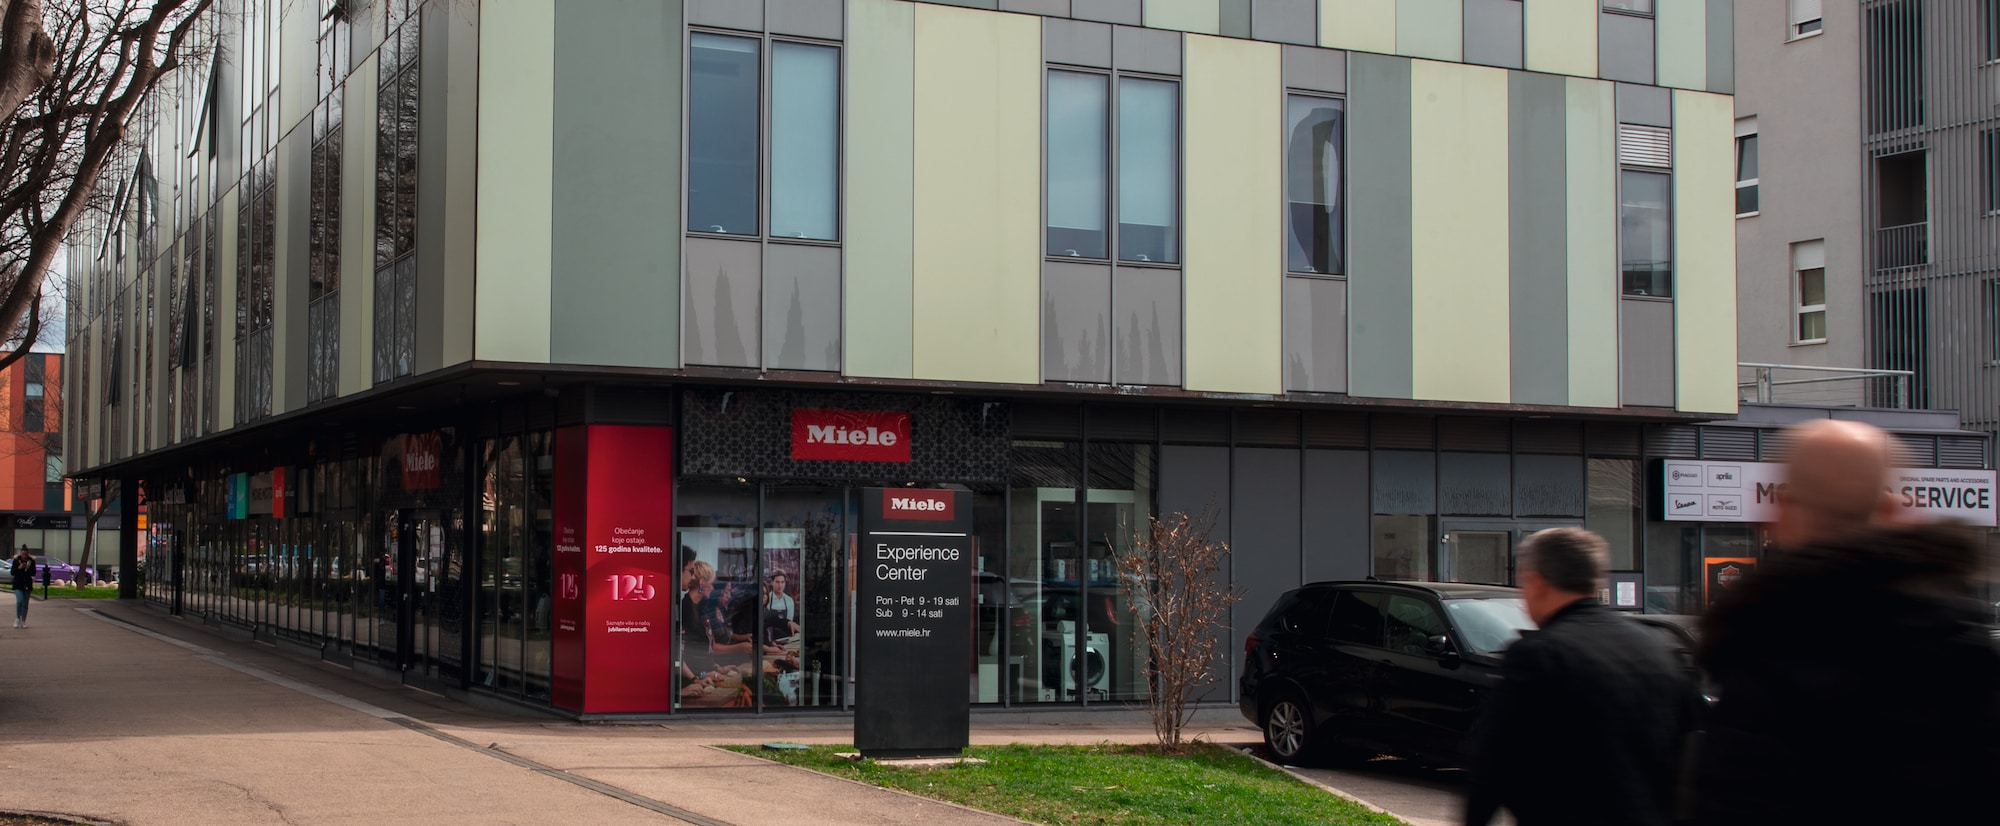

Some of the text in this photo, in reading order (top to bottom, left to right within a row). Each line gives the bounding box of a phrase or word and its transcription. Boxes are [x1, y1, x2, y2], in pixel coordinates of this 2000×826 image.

[807, 425, 897, 446] Miele
[406, 451, 435, 472] Miele
[891, 497, 946, 511] Miele
[1901, 486, 1989, 509] SERVICE
[614, 527, 645, 536] Obećanje
[611, 536, 625, 545] koje
[595, 545, 608, 553] 125
[608, 545, 631, 554] godina
[876, 543, 959, 563] Experience
[876, 564, 927, 580] Center
[605, 574, 656, 601] 125
[876, 595, 893, 605] Pon
[901, 596, 915, 605] Pet
[918, 596, 925, 605] 9
[933, 597, 944, 606] 19
[945, 597, 959, 606] sati
[875, 608, 893, 618] Sub
[902, 609, 908, 618] 9
[917, 609, 926, 617] 14
[928, 609, 943, 618] sati
[875, 628, 931, 637] www.miele.hr
